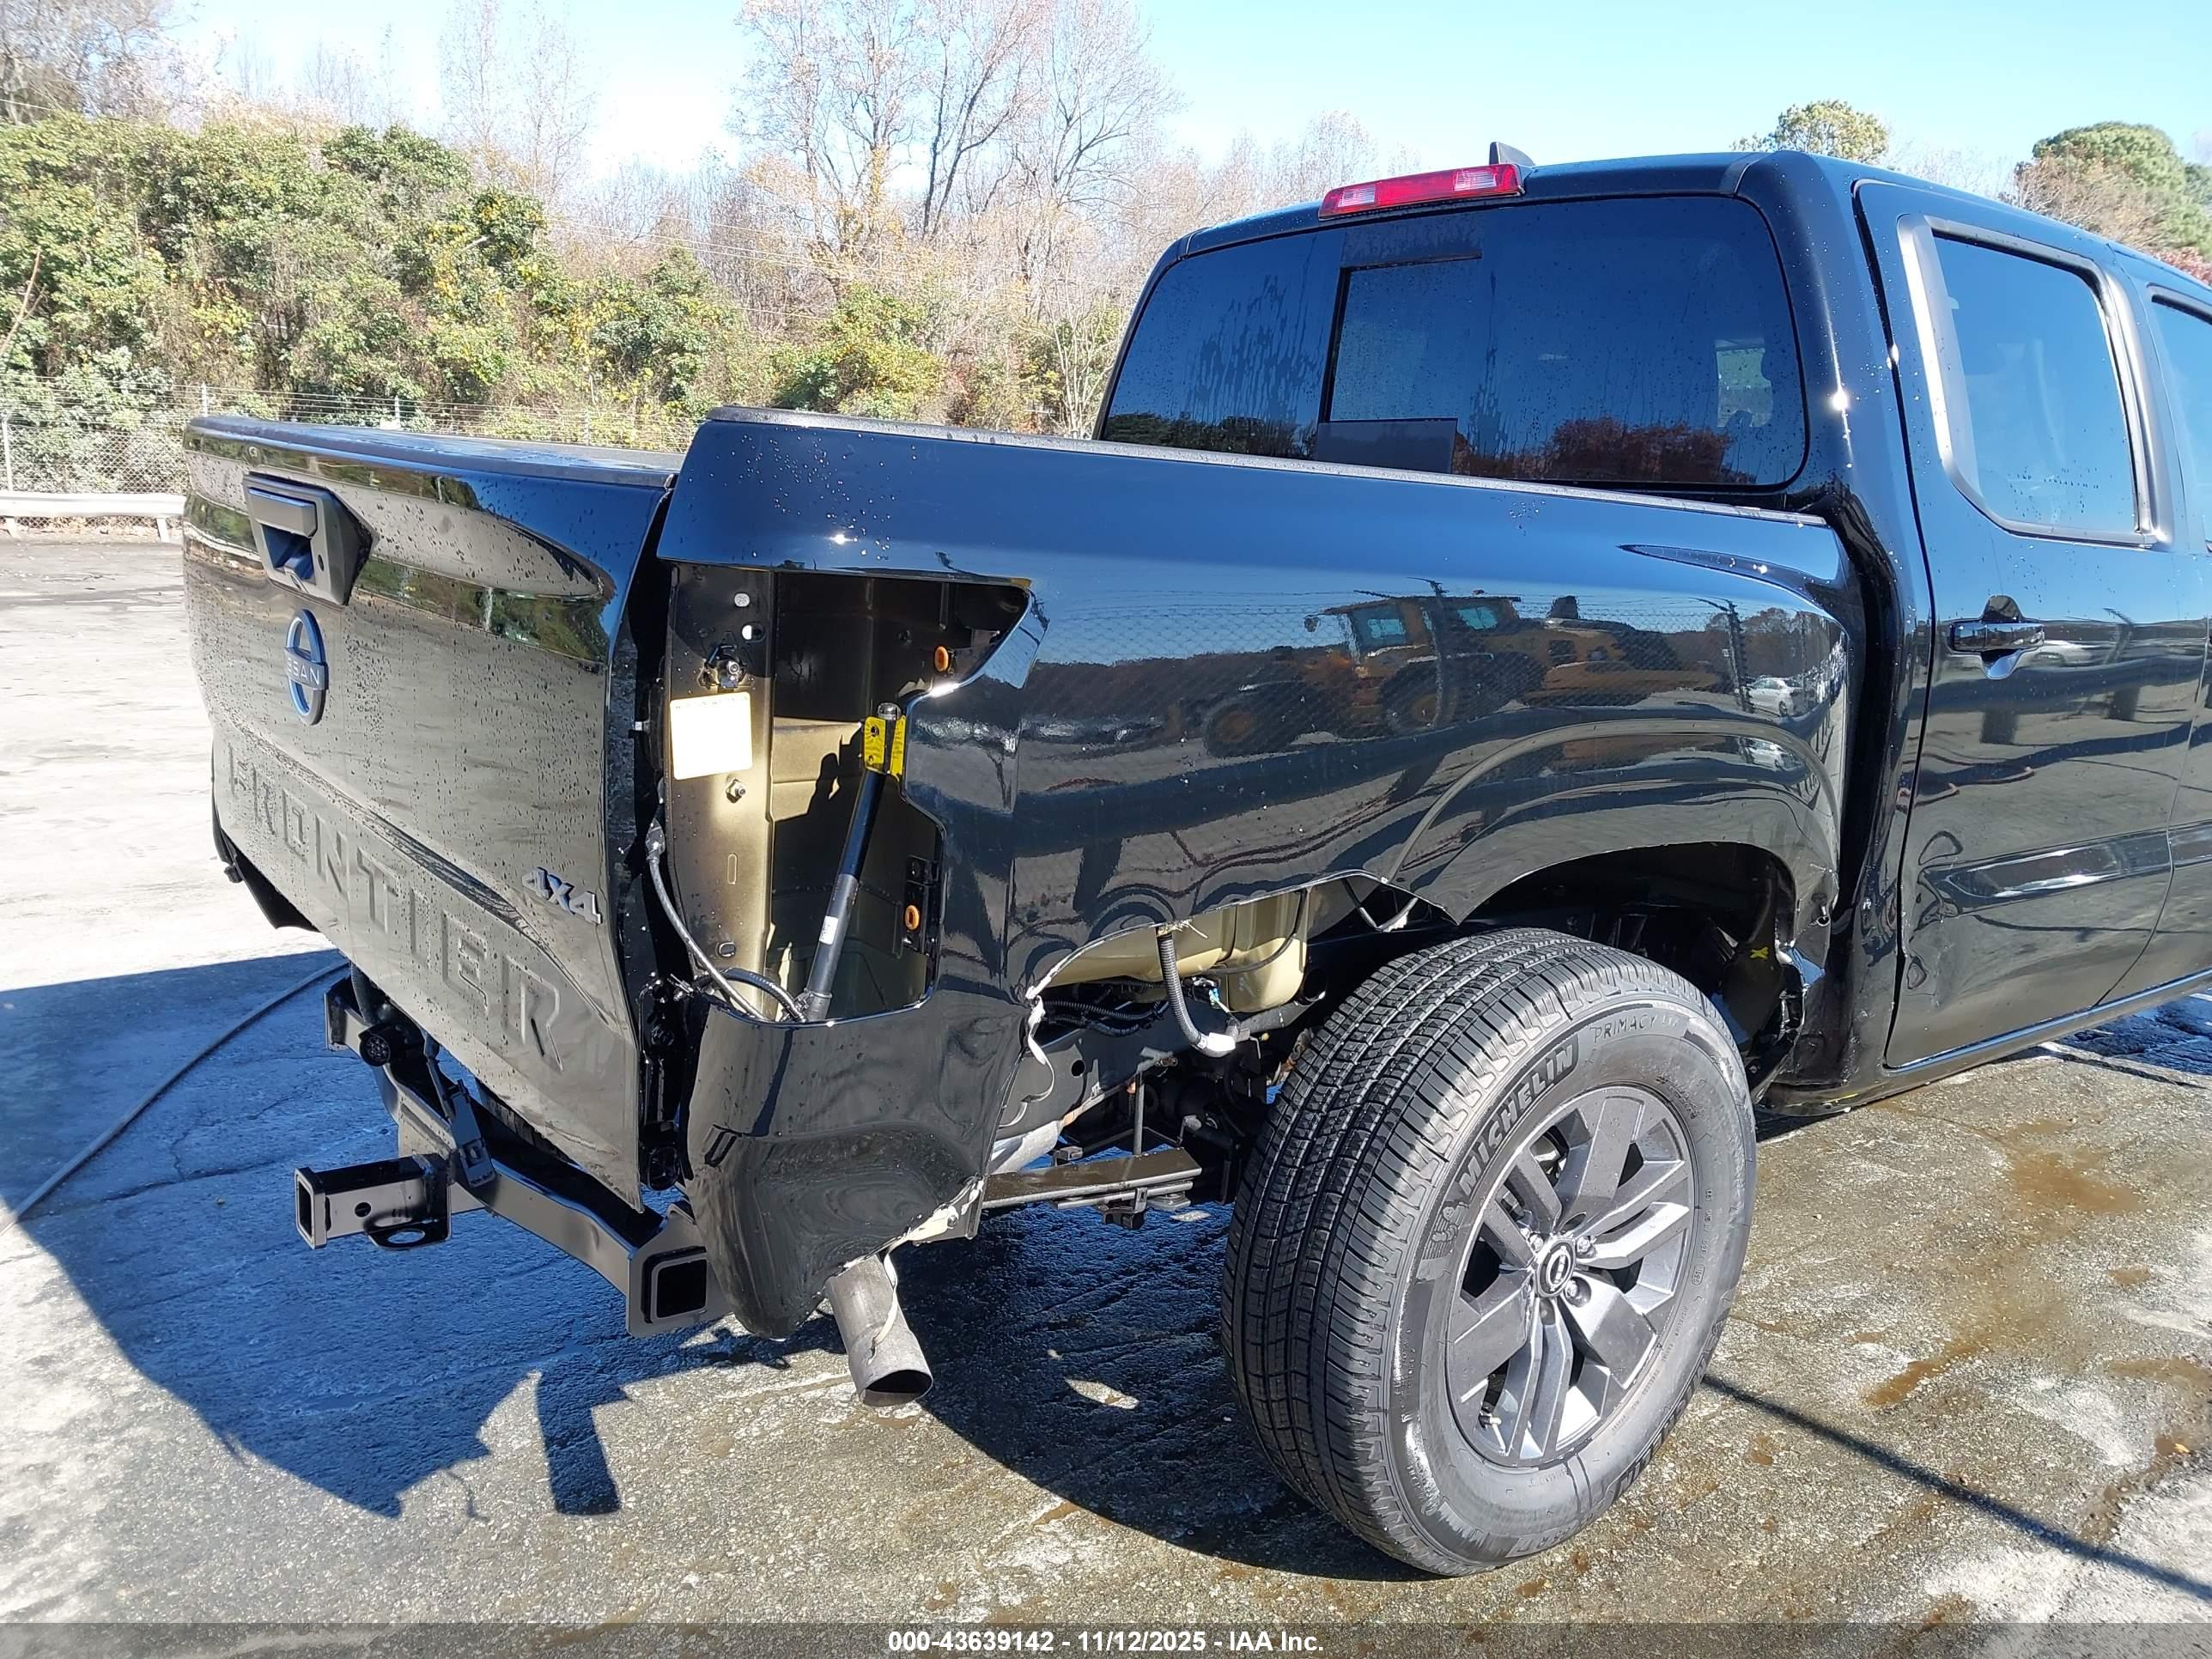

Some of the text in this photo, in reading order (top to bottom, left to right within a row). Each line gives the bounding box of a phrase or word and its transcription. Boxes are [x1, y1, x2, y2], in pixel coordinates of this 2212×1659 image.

[287, 656, 320, 686] SSAN
[227, 742, 564, 1072] FRONTIER
[1590, 1014, 1658, 1043] PRIMACY
[1459, 1043, 1573, 1196] MICHELIN
